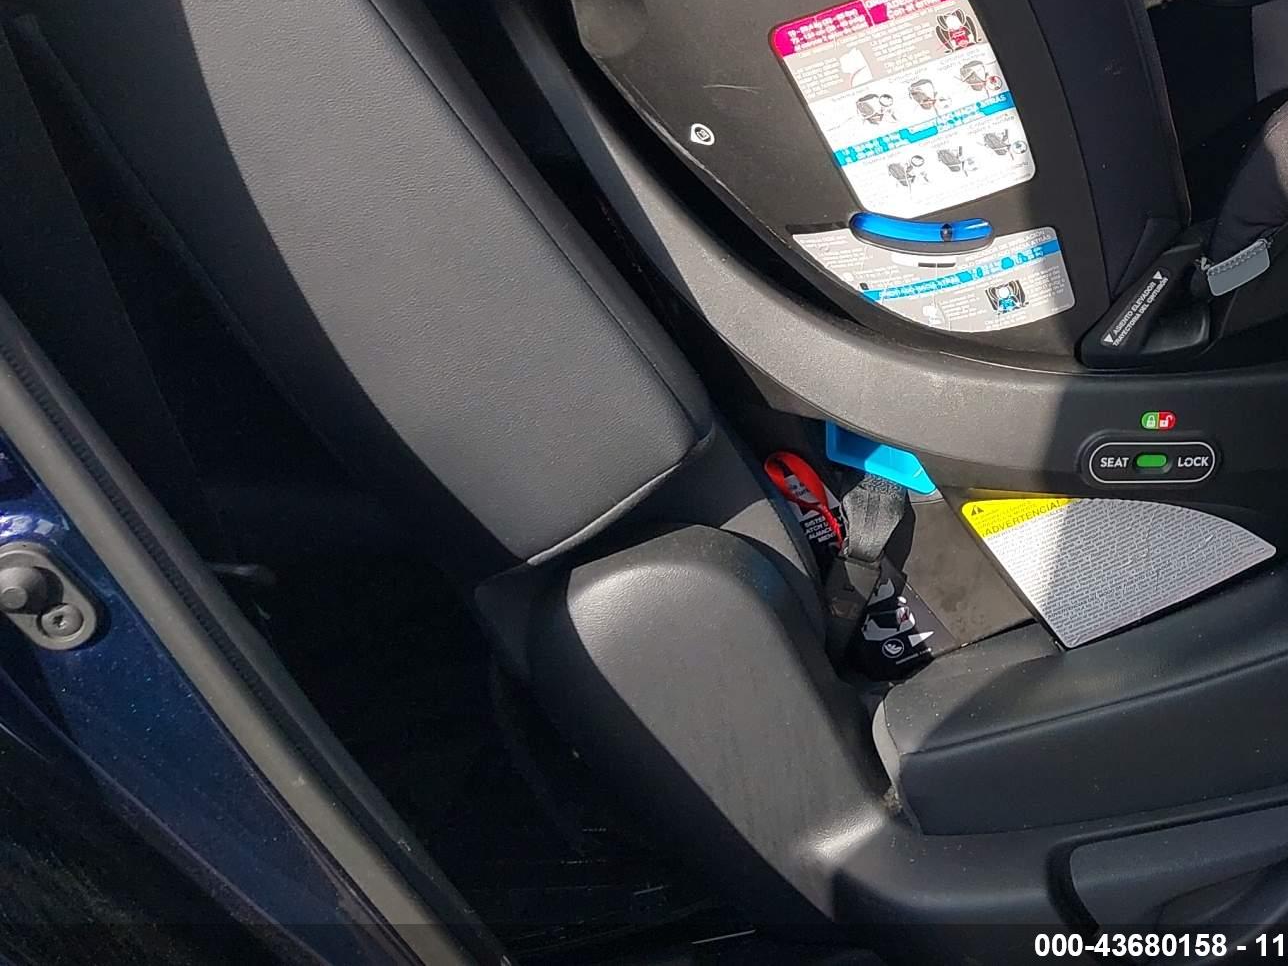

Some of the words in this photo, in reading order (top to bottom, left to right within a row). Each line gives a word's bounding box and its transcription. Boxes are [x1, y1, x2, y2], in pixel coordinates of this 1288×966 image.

[1112, 313, 1141, 346] TRAYECTORIA
[1138, 303, 1149, 314] DEL
[1113, 311, 1133, 335] ASIENTO
[1131, 281, 1156, 312] ELEVADOR
[1100, 457, 1129, 468] SEAT
[1177, 456, 1209, 468] LOCK
